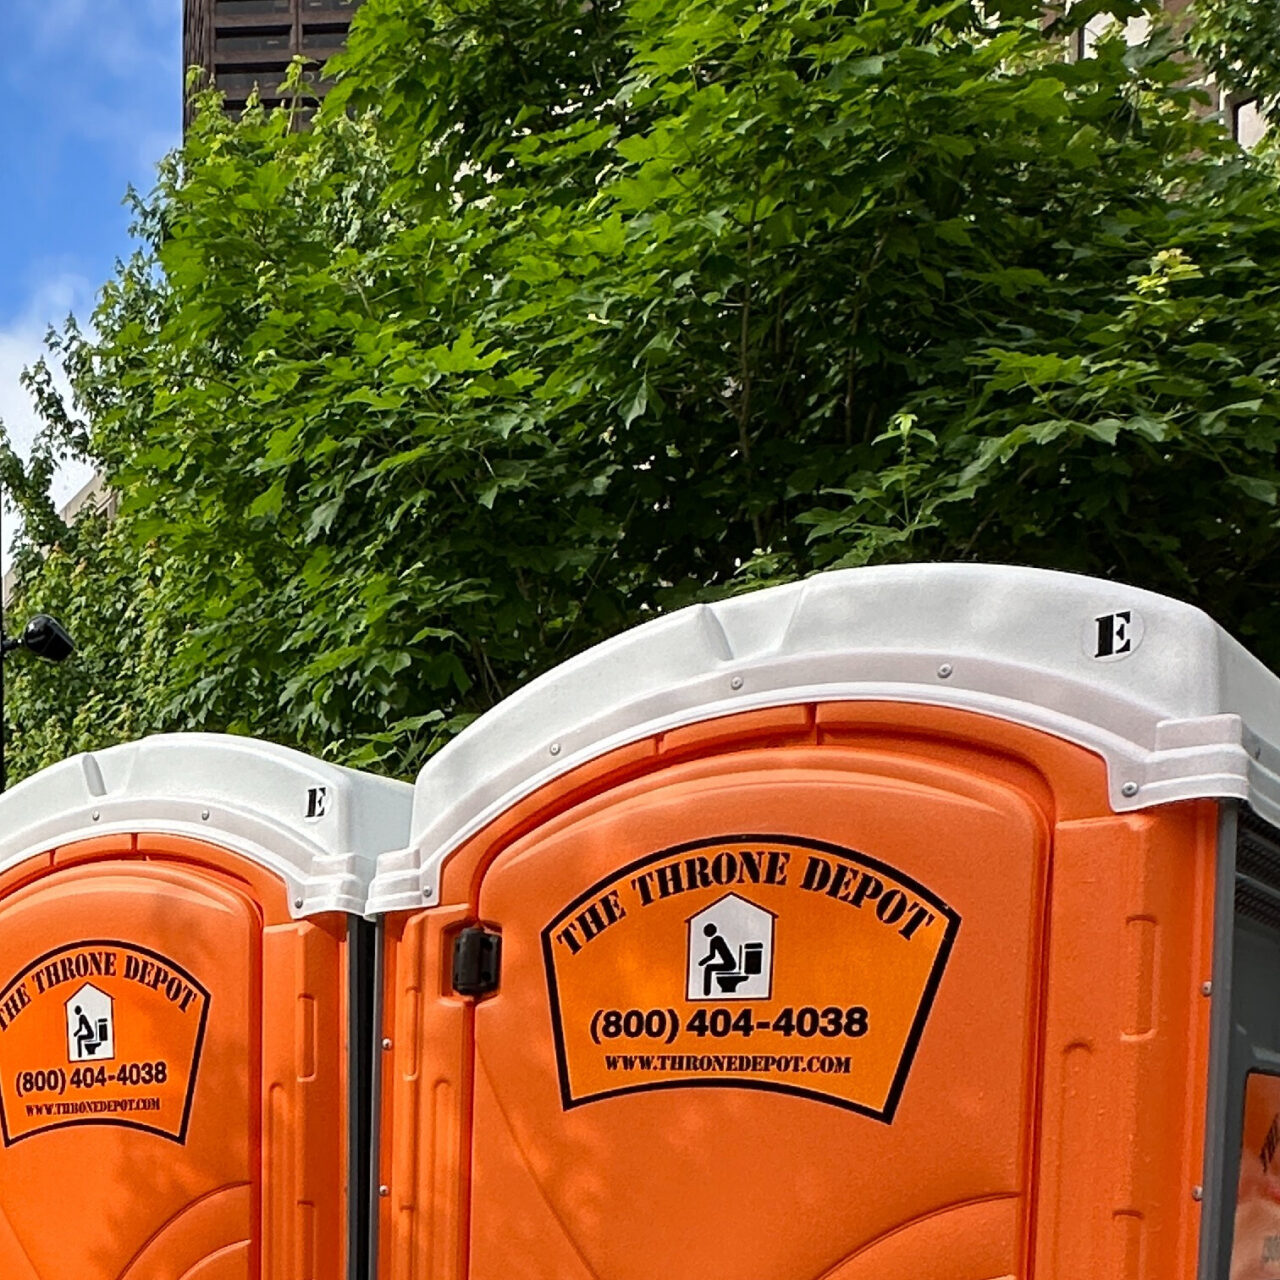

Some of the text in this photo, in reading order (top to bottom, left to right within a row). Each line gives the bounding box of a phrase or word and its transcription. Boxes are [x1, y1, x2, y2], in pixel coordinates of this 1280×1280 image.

[1094, 610, 1131, 658] E
[305, 787, 326, 818] E
[556, 851, 936, 955] THE THRONE DEPOT
[32, 951, 117, 995] THRONE
[122, 954, 198, 1014] DEPOT
[589, 1006, 869, 1045] (800) 404-4038
[15, 1061, 167, 1098] (800) 404-4038
[605, 1054, 852, 1073] WWW.THRONEDEPOT.COM
[25, 1097, 161, 1117] WWW.THRONEDEPOT.COM
